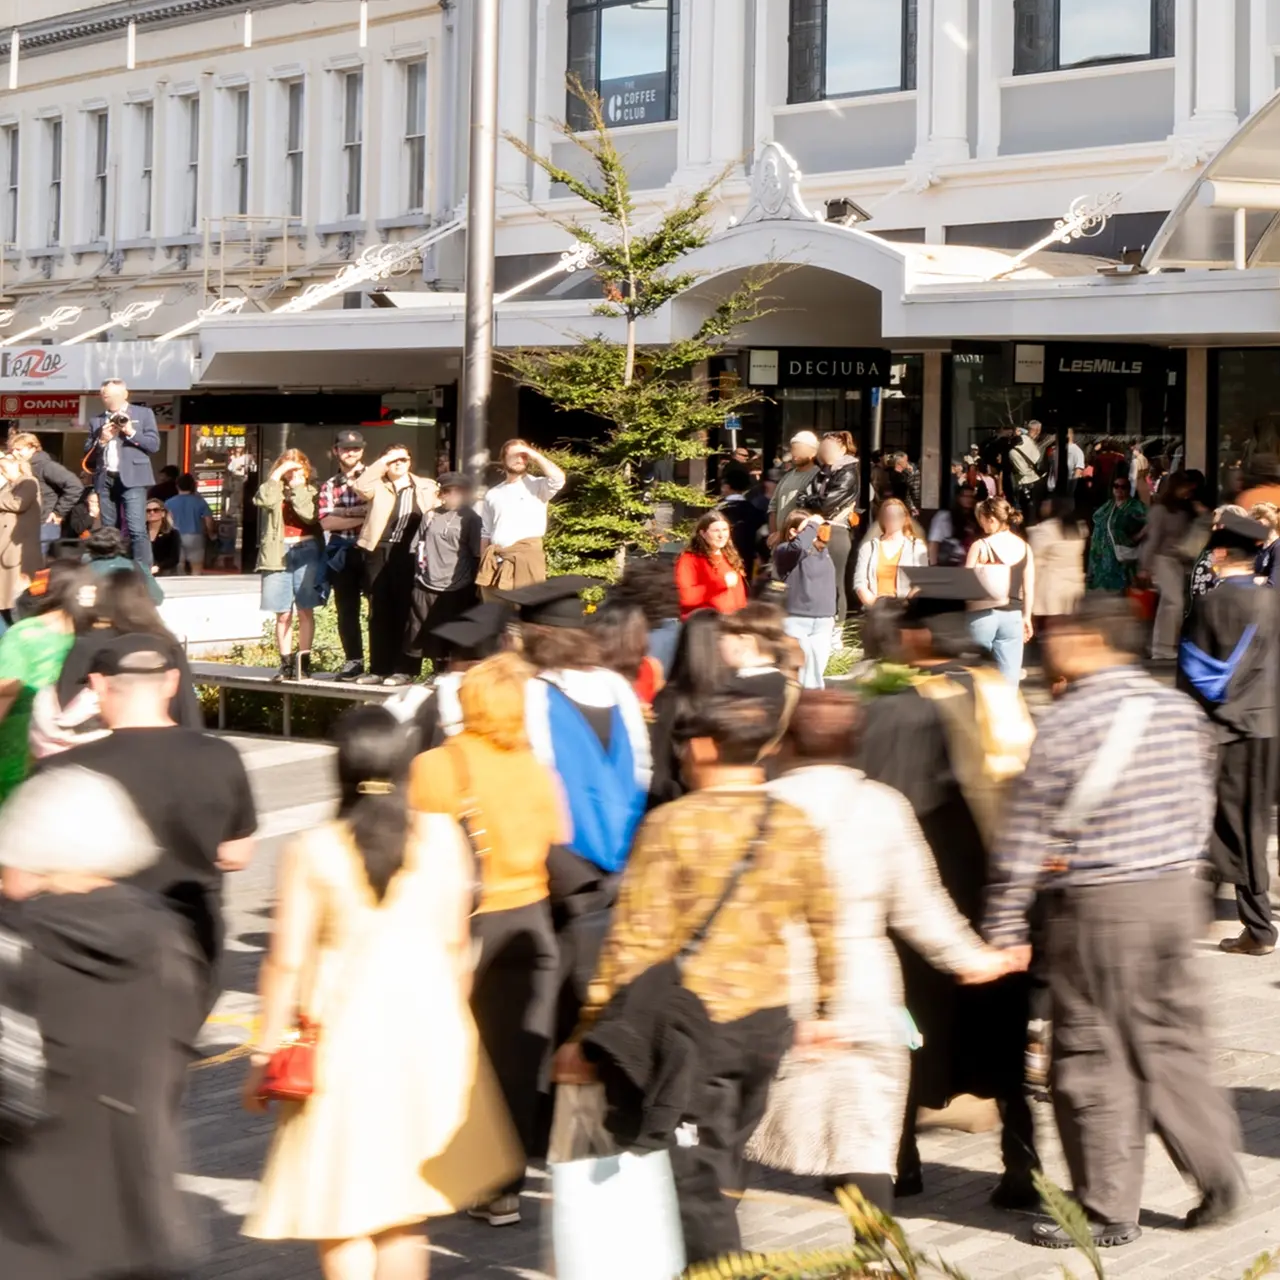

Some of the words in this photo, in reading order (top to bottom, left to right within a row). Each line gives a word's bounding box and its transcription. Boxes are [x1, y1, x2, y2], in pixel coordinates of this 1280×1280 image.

[624, 81, 636, 89] THE
[623, 89, 656, 105] COFFEE
[623, 107, 646, 121] CLUB
[789, 360, 880, 376] DECJUBA
